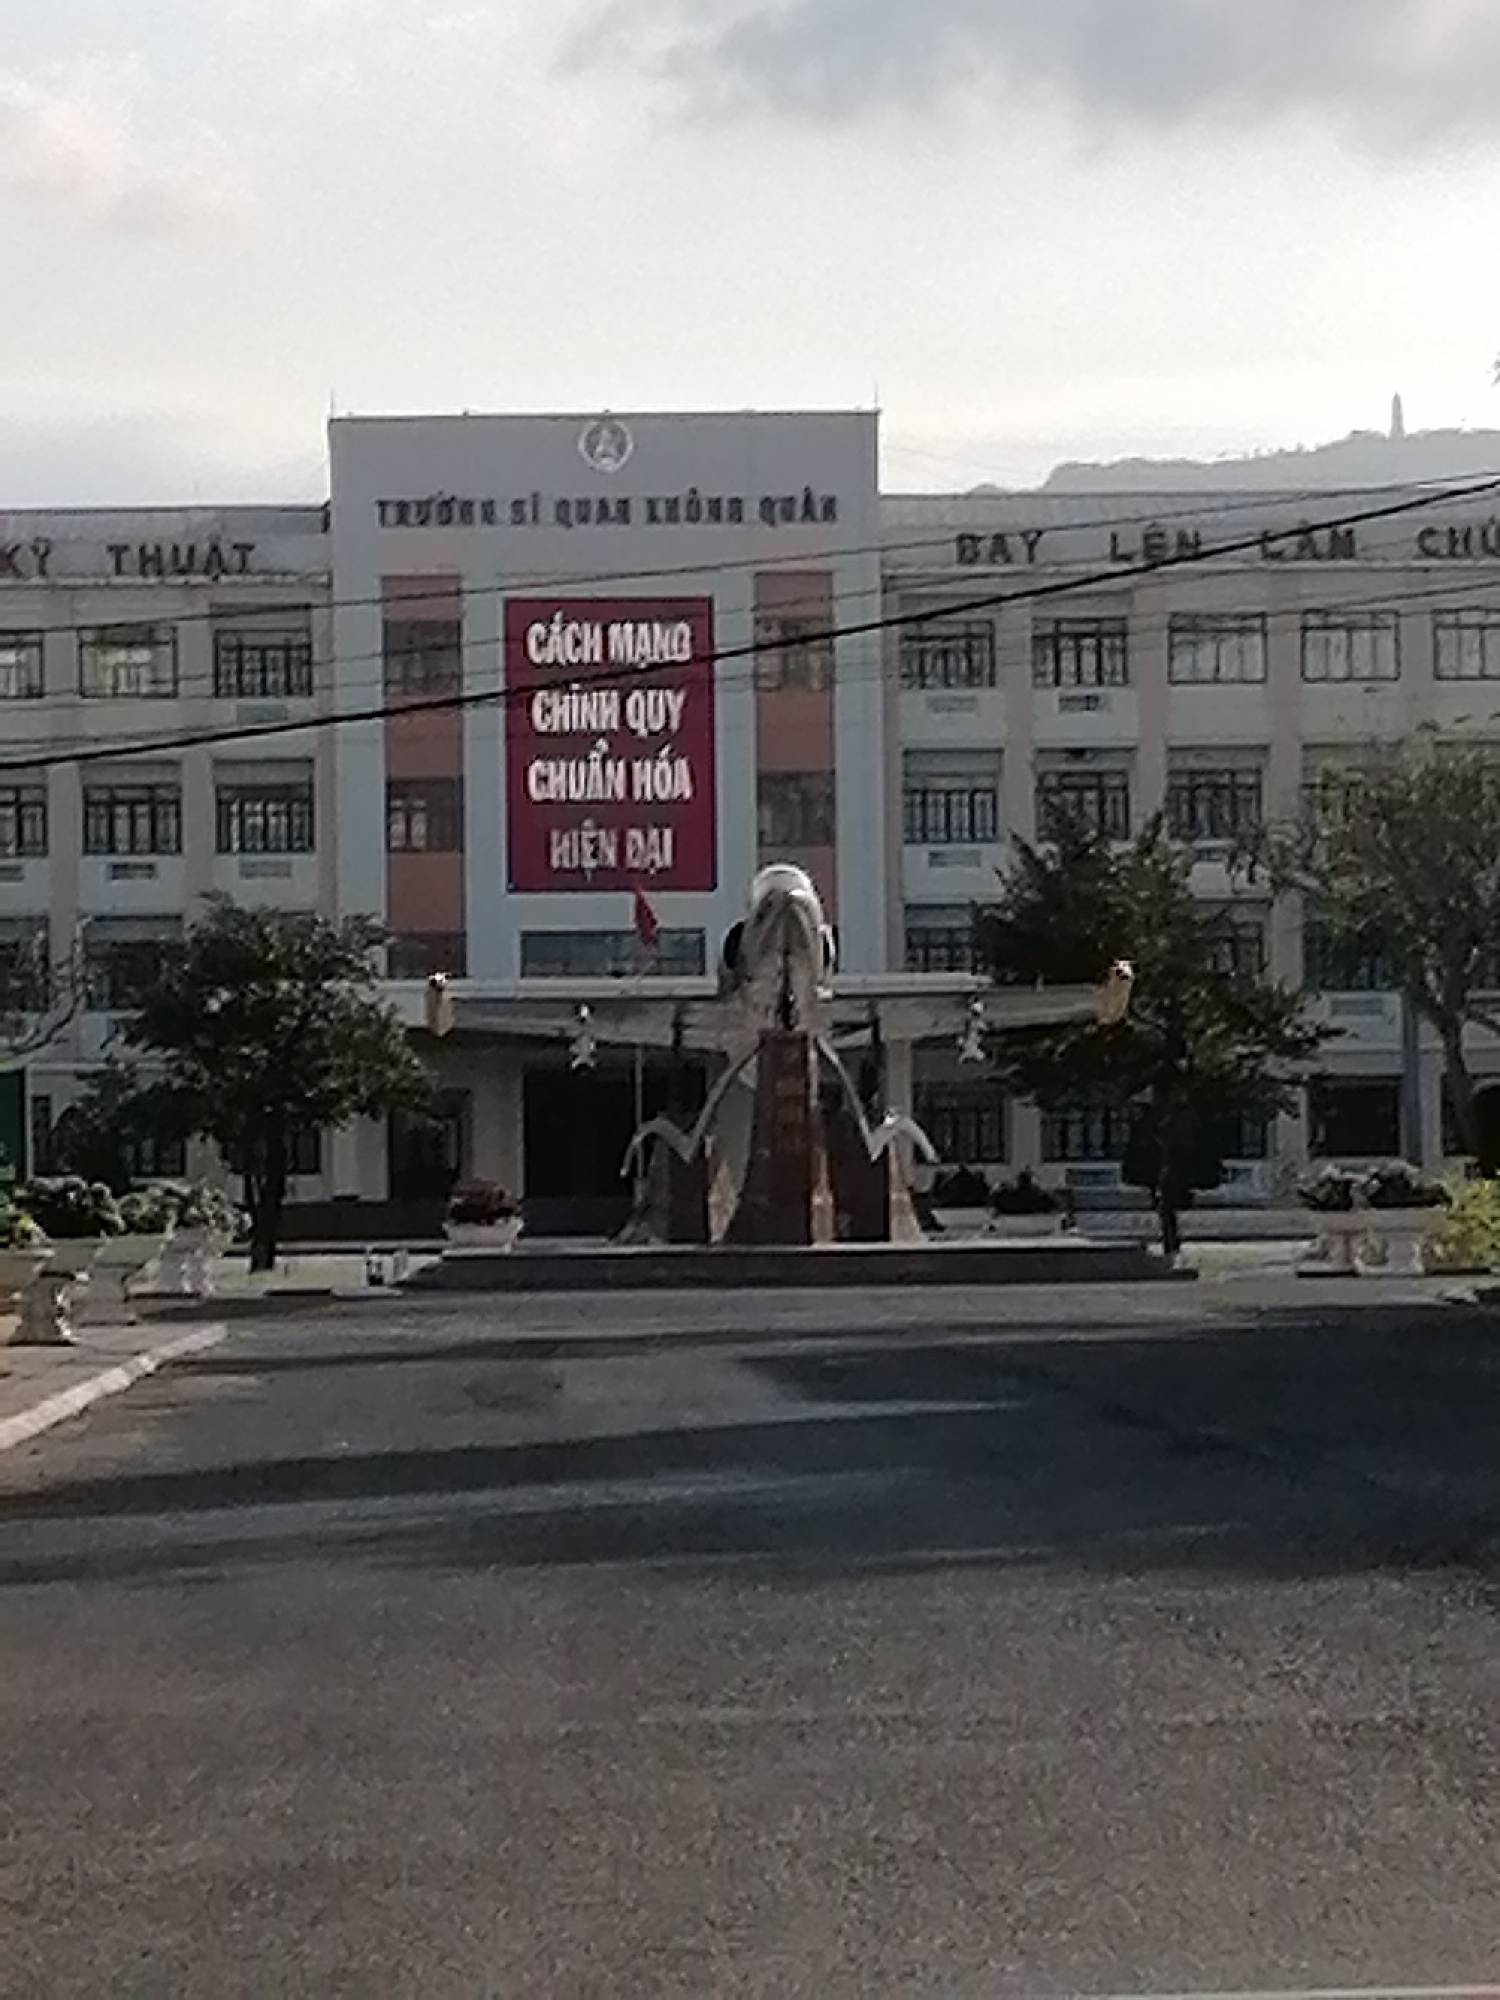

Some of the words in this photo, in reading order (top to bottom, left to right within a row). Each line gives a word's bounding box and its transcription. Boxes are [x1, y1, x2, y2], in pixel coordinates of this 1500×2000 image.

[526, 610, 603, 666] CÁCH
[625, 689, 687, 736] QUY
[527, 738, 628, 802] CHUẨN
[632, 744, 695, 802] HÓA
[549, 818, 618, 881] HIỆN
[625, 826, 674, 874] ĐẠI
